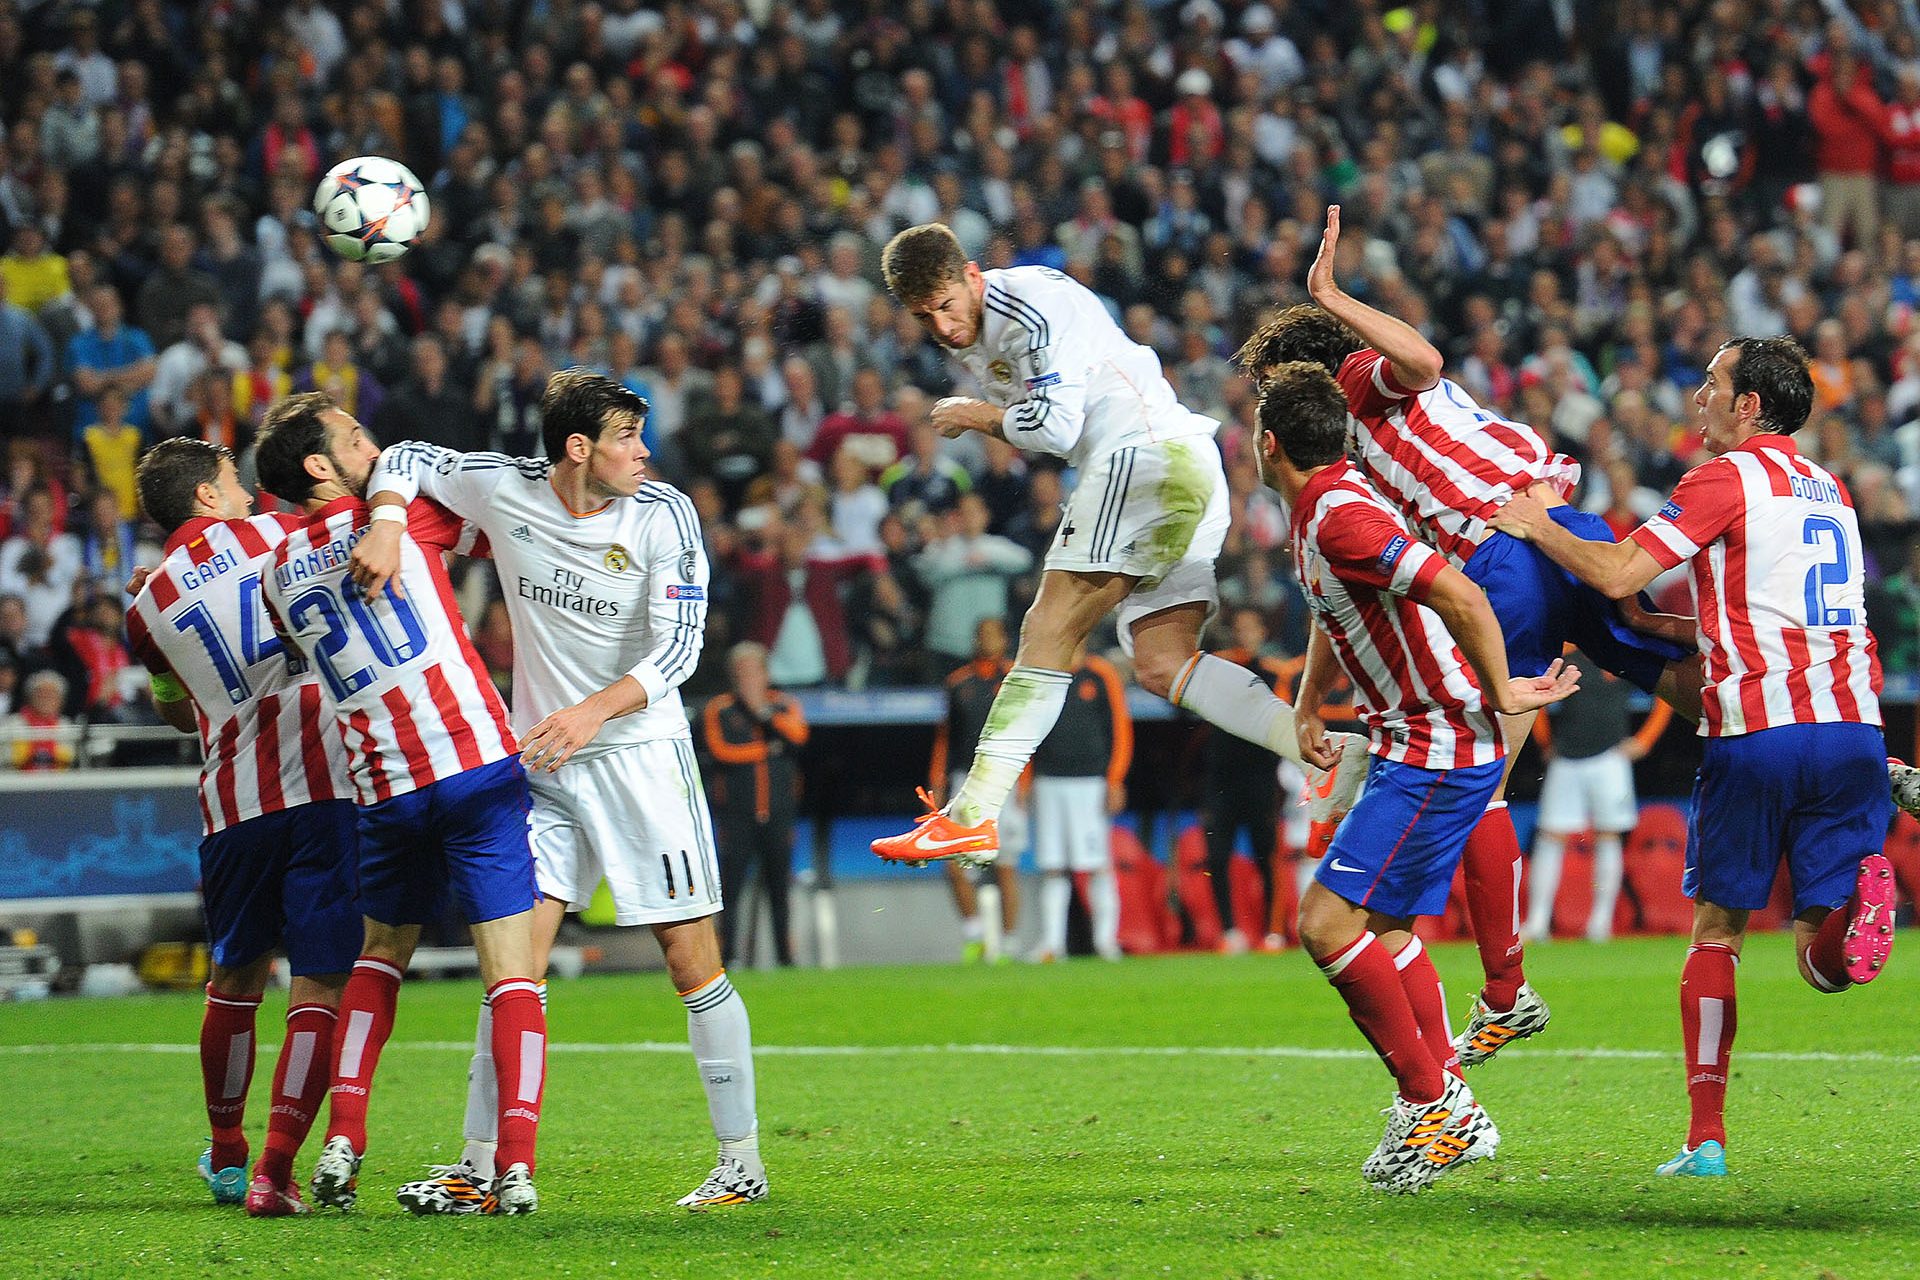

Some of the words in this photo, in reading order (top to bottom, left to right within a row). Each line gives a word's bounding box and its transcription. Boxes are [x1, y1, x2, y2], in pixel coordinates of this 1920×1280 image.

[182, 549, 239, 591] GABI
[553, 568, 585, 592] Fly
[1803, 514, 1856, 626] 2
[518, 576, 620, 617] Emirates
[171, 571, 309, 706] 14
[288, 578, 429, 704] 20
[662, 850, 695, 899] 11
